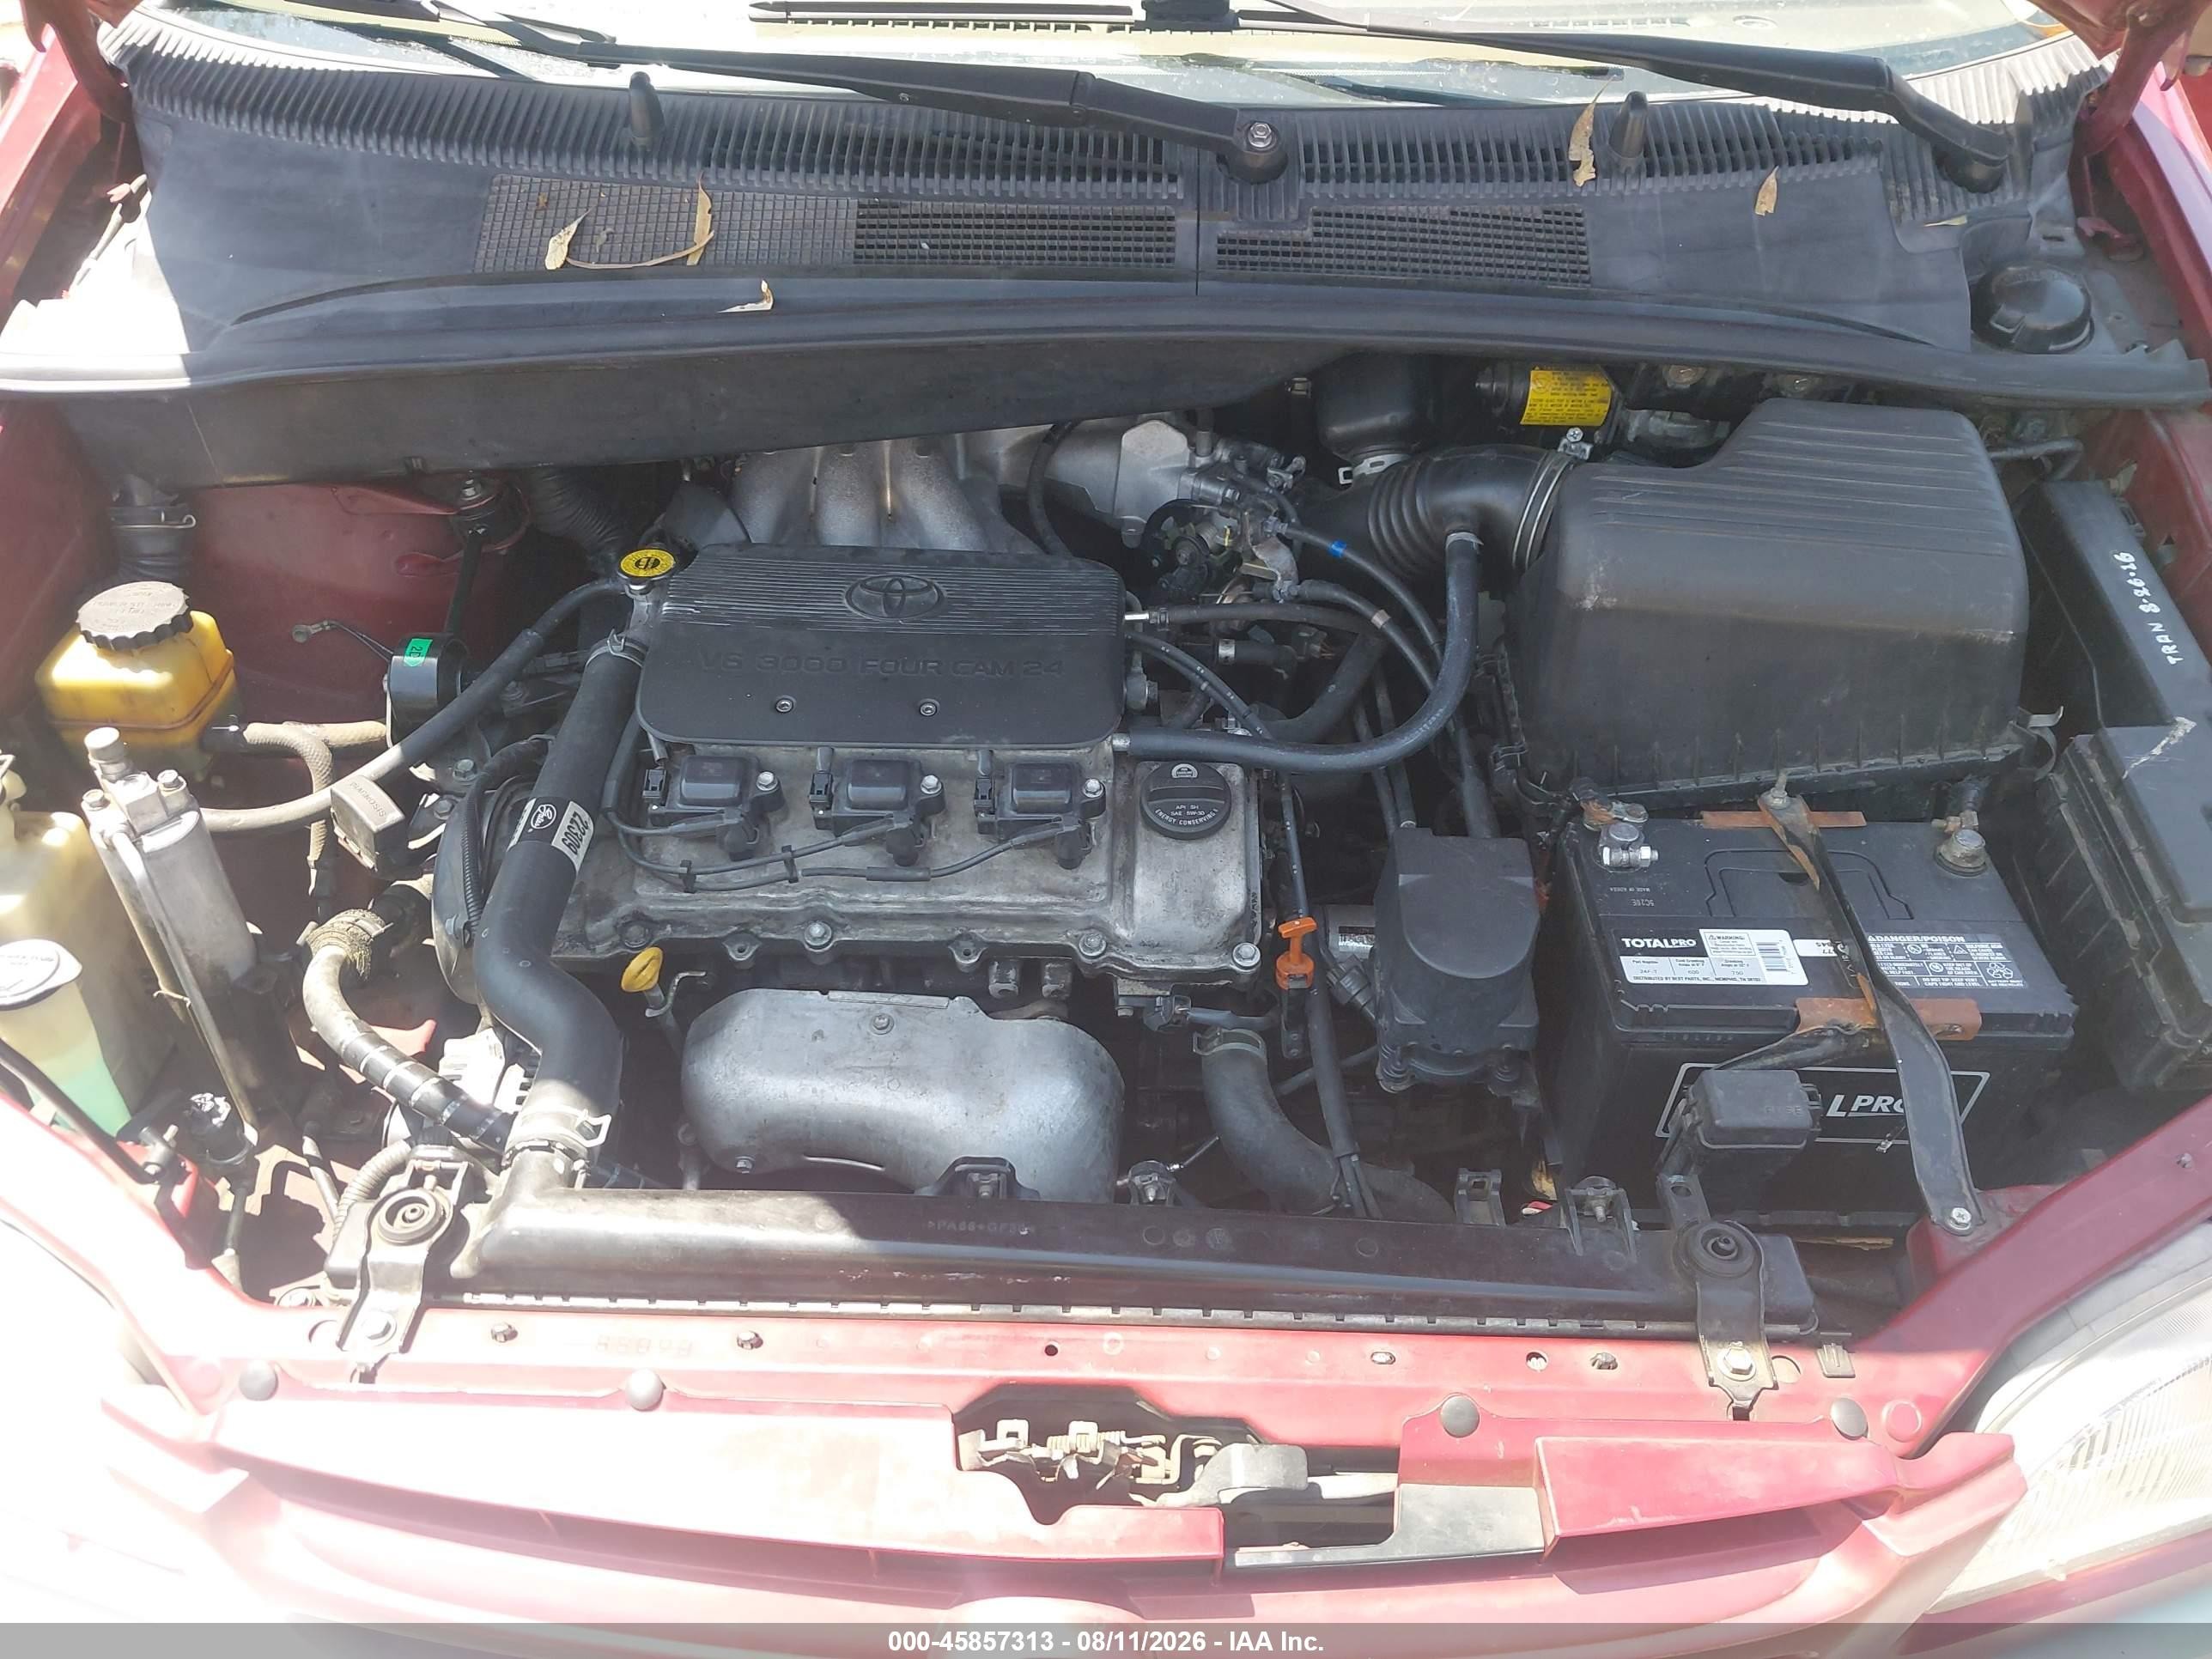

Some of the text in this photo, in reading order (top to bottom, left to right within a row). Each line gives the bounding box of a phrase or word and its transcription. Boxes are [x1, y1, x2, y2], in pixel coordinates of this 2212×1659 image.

[2147, 623, 2184, 665] TRAN
[860, 658, 943, 676] FOUR
[951, 659, 1014, 677] CAM
[1021, 659, 1058, 677] 24
[1155, 808, 1176, 823] ENERGY
[1178, 811, 1216, 826] CONSERVING
[562, 810, 589, 855] 22309
[1621, 938, 1697, 949] TOTALPRO
